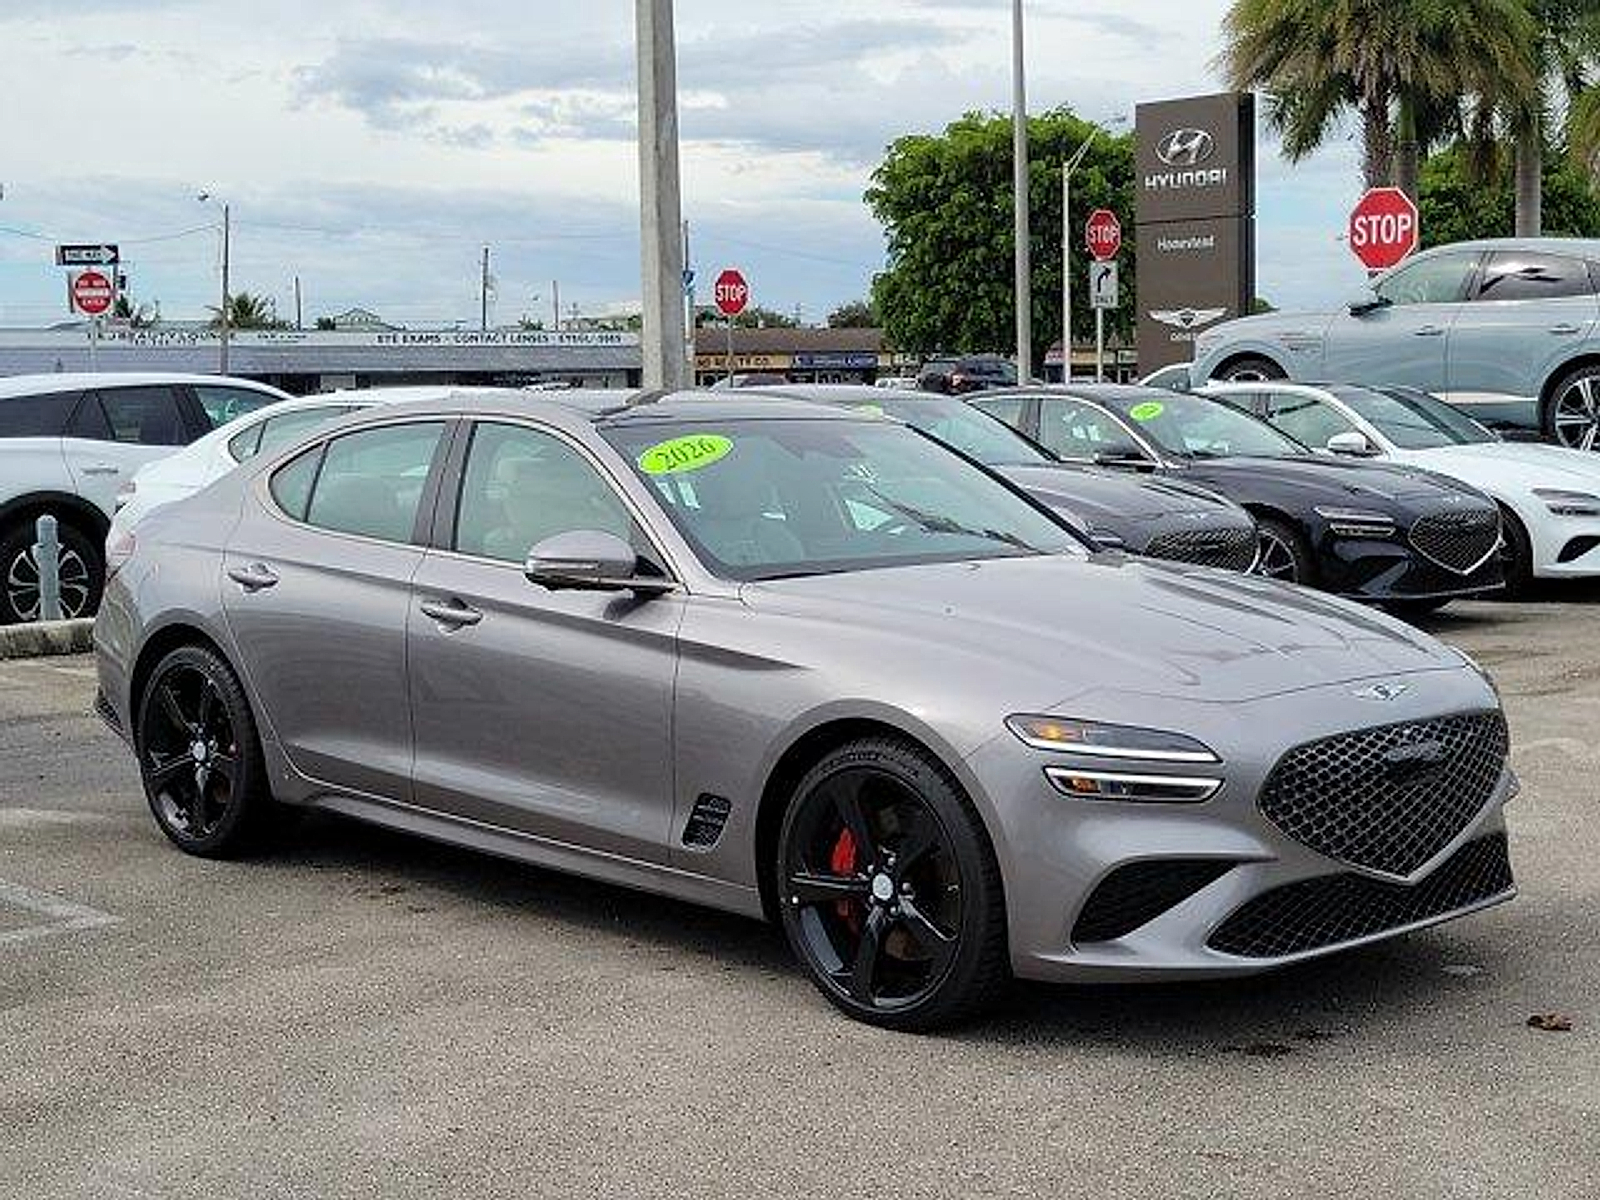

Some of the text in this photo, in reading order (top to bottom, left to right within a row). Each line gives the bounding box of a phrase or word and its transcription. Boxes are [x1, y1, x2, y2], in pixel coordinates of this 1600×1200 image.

[1144, 168, 1227, 189] HYUNDAI
[1089, 224, 1119, 244] STOP
[1353, 213, 1411, 246] STOP
[717, 284, 747, 302] STOP
[655, 438, 716, 470] 2026
